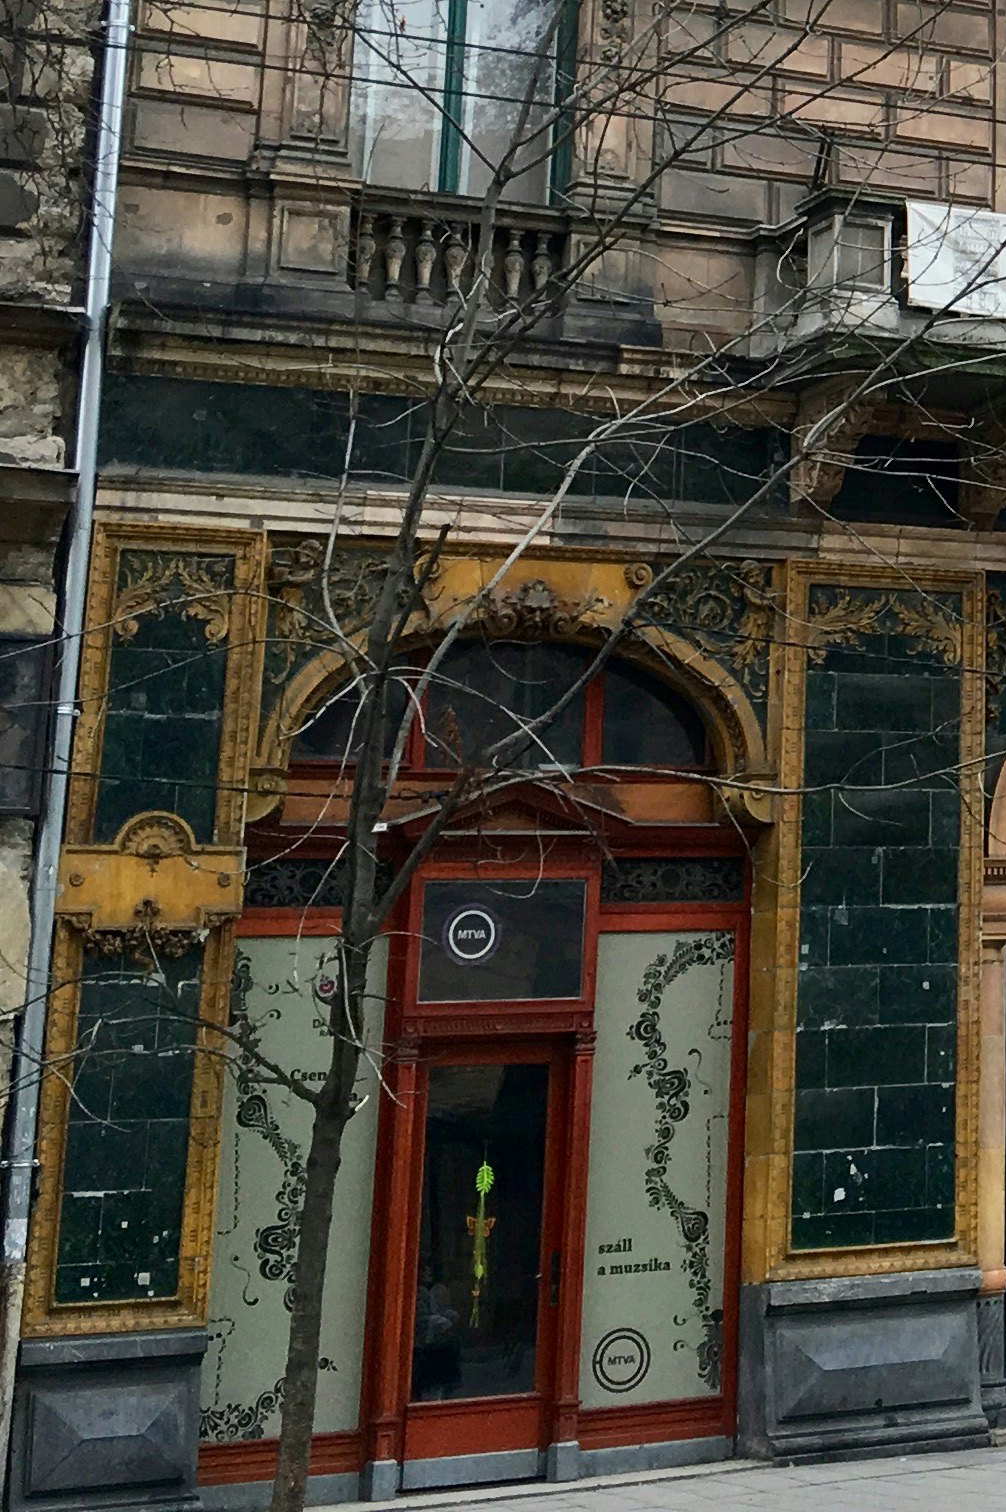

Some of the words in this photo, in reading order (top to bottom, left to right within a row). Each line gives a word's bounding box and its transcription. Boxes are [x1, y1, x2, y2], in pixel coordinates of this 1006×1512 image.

[457, 929, 487, 939] MTVA
[598, 1238, 633, 1254] száll
[597, 1266, 606, 1276] a
[609, 1258, 671, 1275] muzsika
[607, 1355, 636, 1366] MTVA
